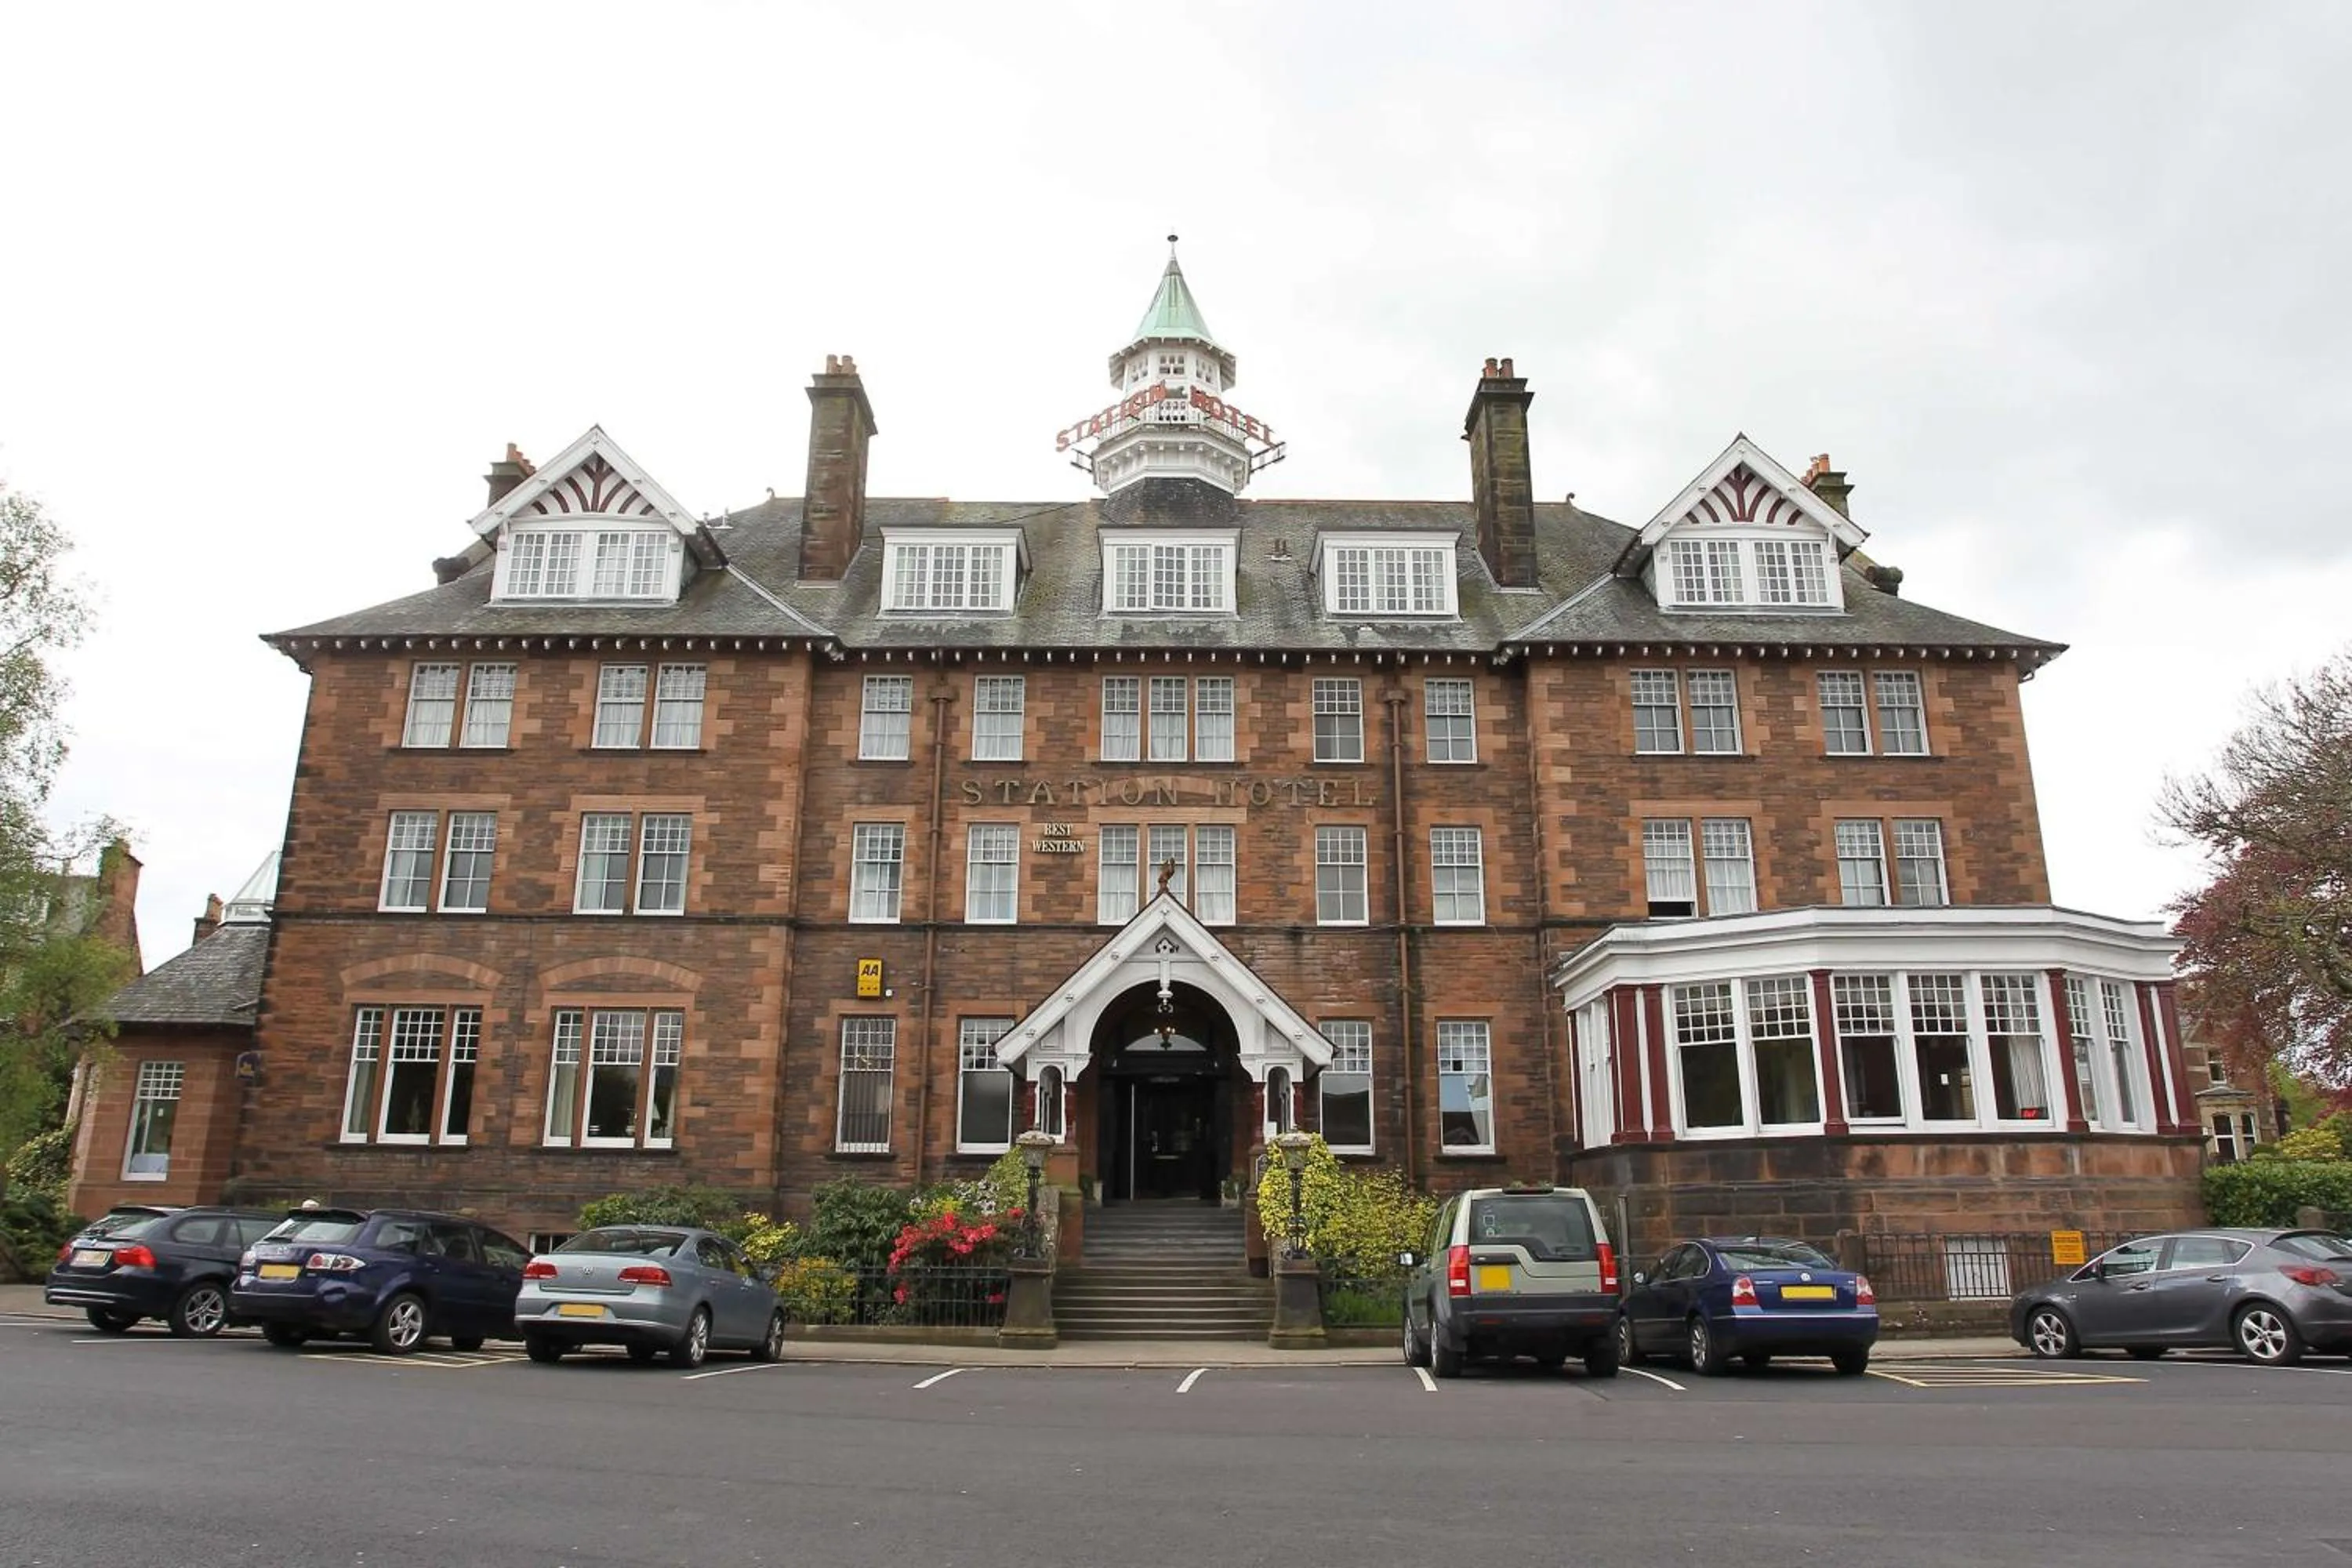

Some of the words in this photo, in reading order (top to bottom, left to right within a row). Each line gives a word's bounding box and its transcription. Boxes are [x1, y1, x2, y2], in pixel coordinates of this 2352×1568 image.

[1055, 380, 1166, 452] STATION
[1190, 385, 1276, 449] HOTEL
[961, 779, 1178, 806] STATION
[1214, 779, 1376, 807] HOTEL
[1044, 822, 1073, 836] BEST
[1033, 840, 1085, 852] WESTERN
[861, 964, 879, 976] AA
